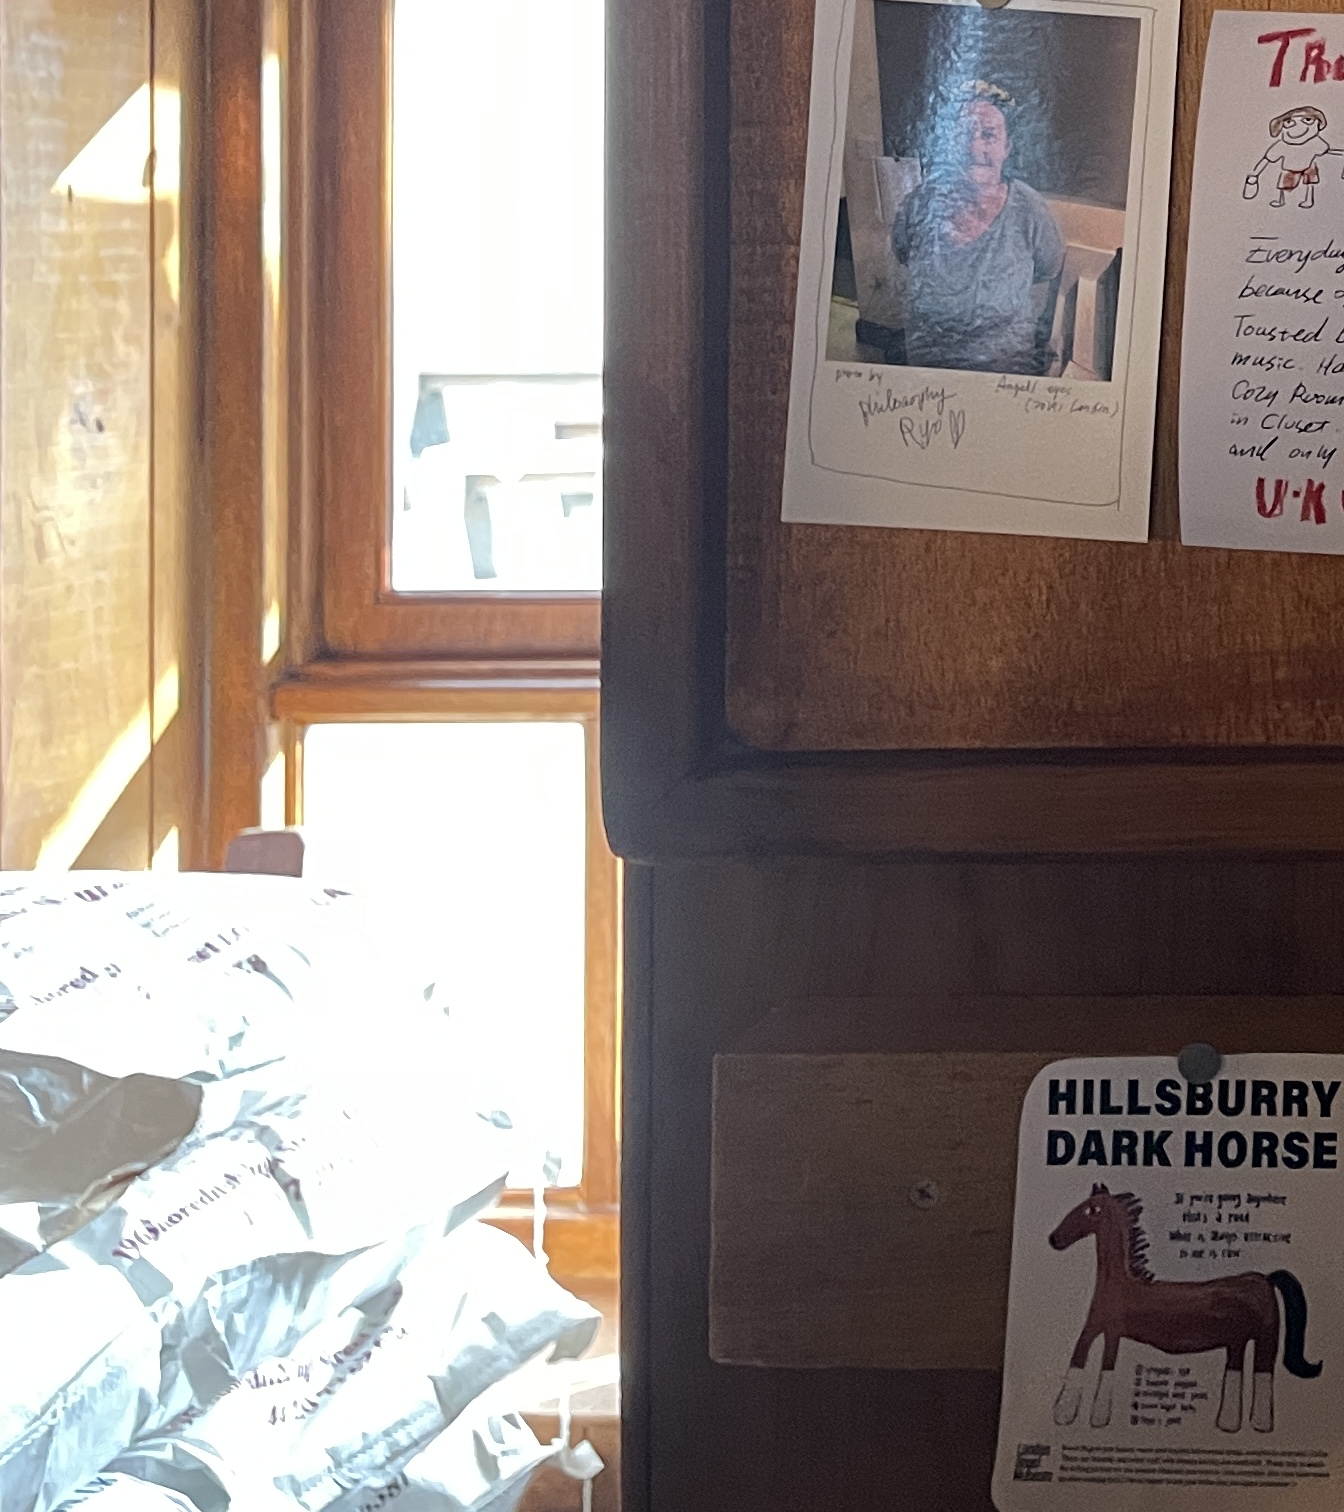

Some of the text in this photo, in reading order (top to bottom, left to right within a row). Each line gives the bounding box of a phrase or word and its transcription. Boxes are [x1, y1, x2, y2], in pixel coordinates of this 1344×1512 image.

[1238, 276, 1323, 304] because
[1232, 380, 1279, 408] Cozy
[1289, 383, 1344, 405] Room
[1231, 413, 1248, 425] in
[1229, 443, 1270, 461] and
[1289, 445, 1337, 469] only
[1048, 1079, 1342, 1118] HILLSBURRY
[1047, 1130, 1337, 1169] DARK HORSE
